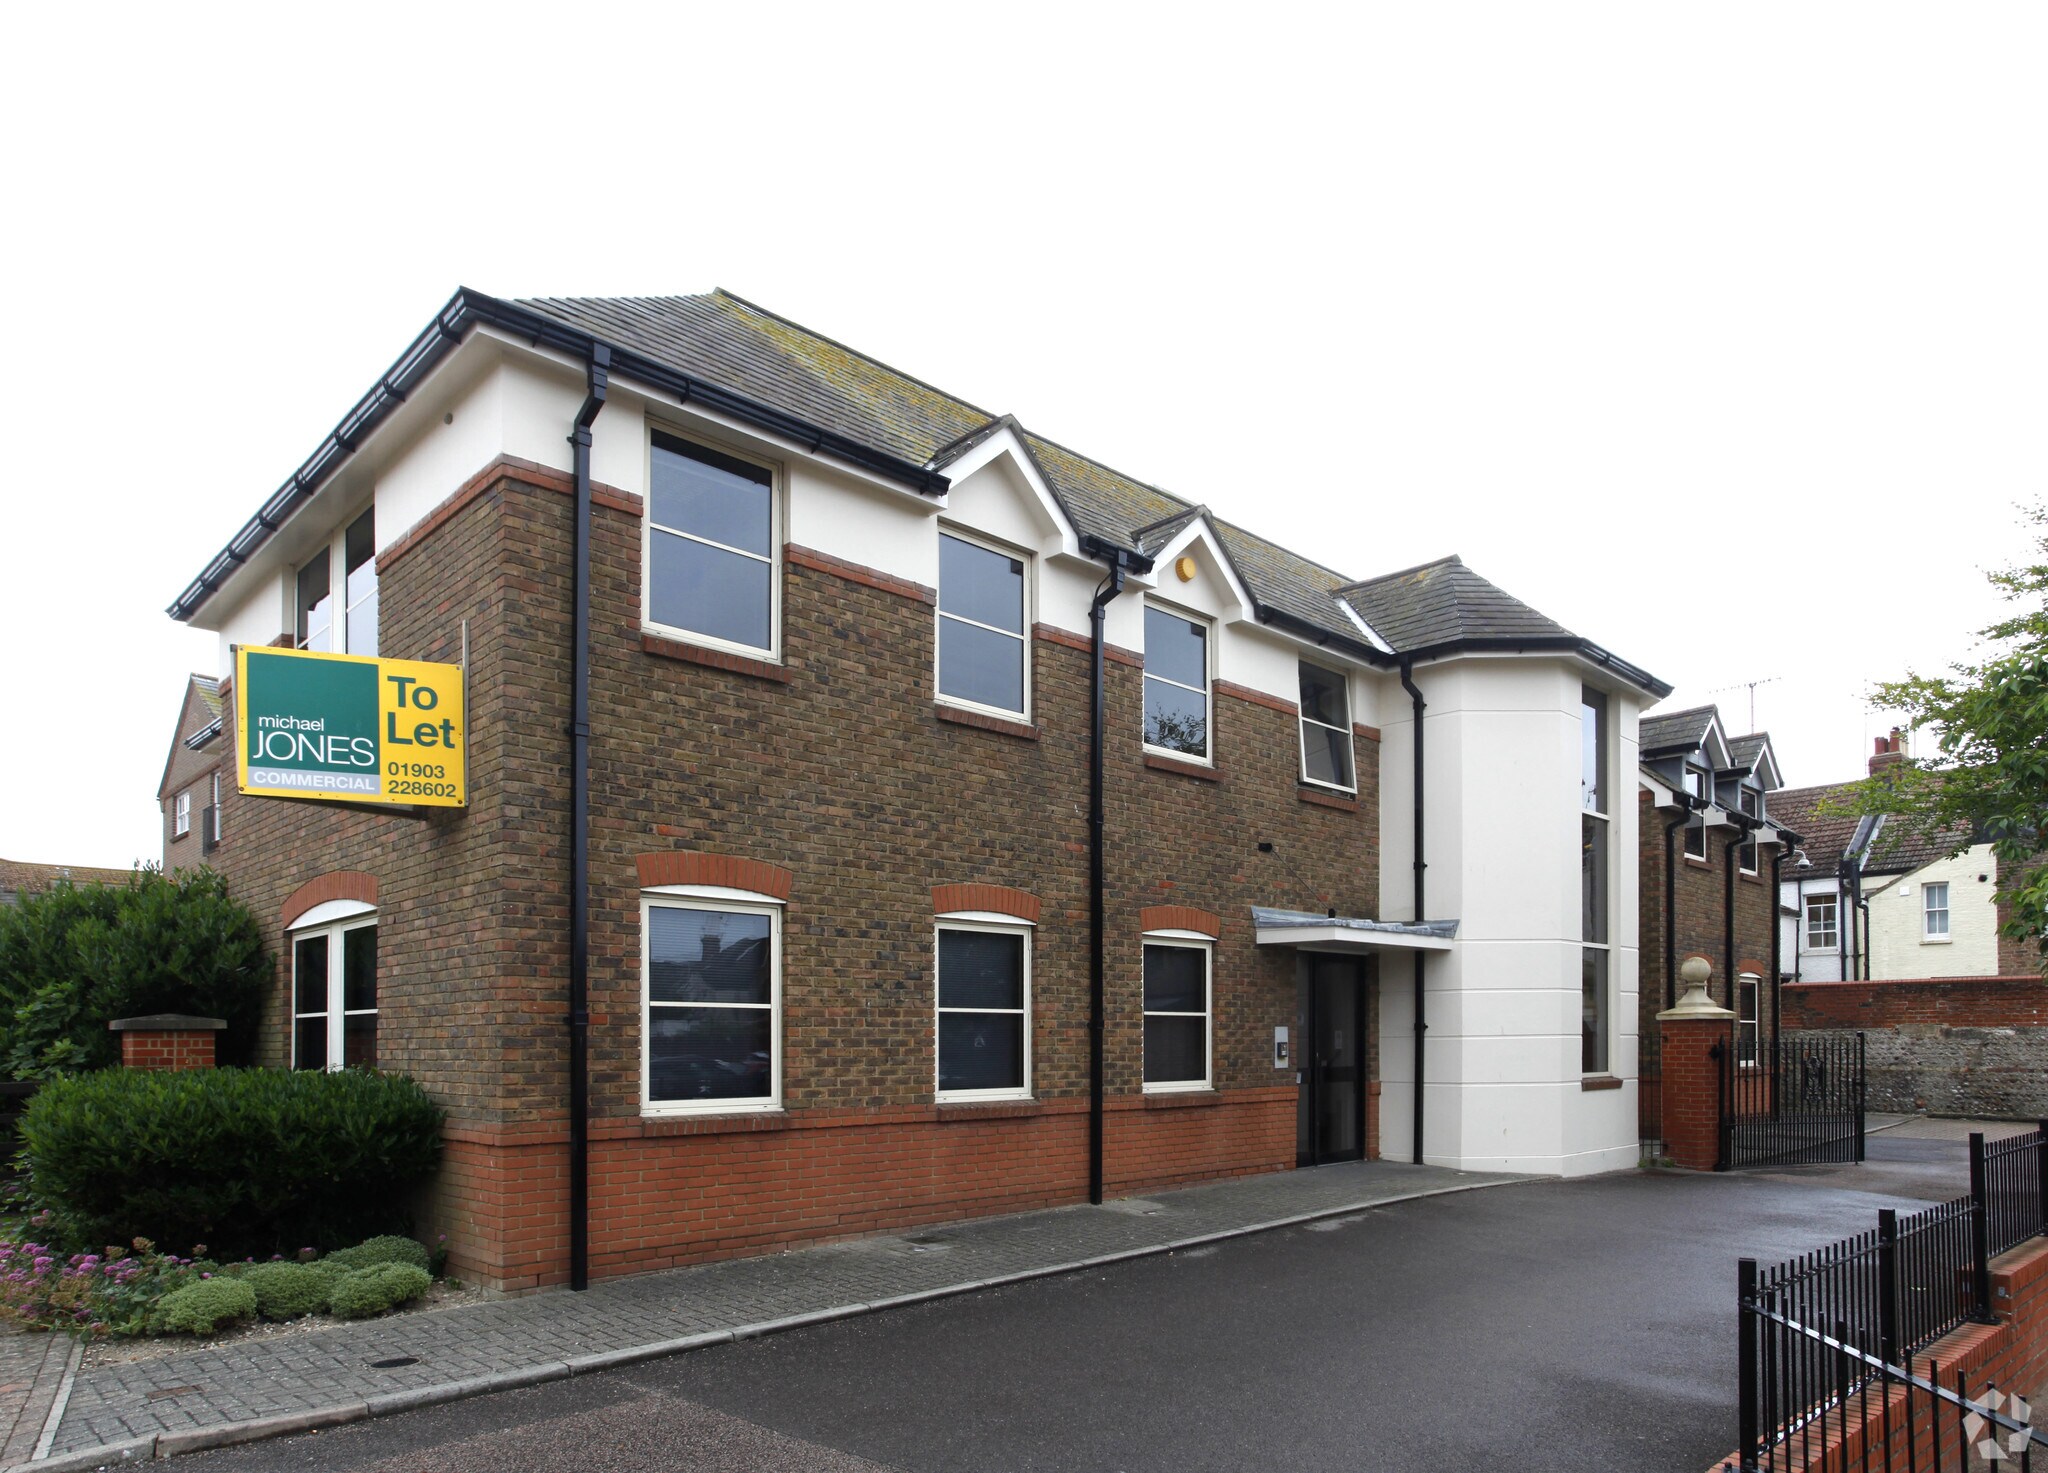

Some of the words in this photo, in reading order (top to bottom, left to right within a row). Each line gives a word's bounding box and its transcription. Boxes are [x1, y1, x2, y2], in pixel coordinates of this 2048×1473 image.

[387, 675, 438, 711] To
[258, 715, 324, 732] michael
[387, 711, 455, 749] Let
[253, 730, 375, 767] JONES
[388, 761, 445, 779] 01903
[254, 771, 375, 791] COMMERCIAL
[388, 780, 456, 798] 228602
